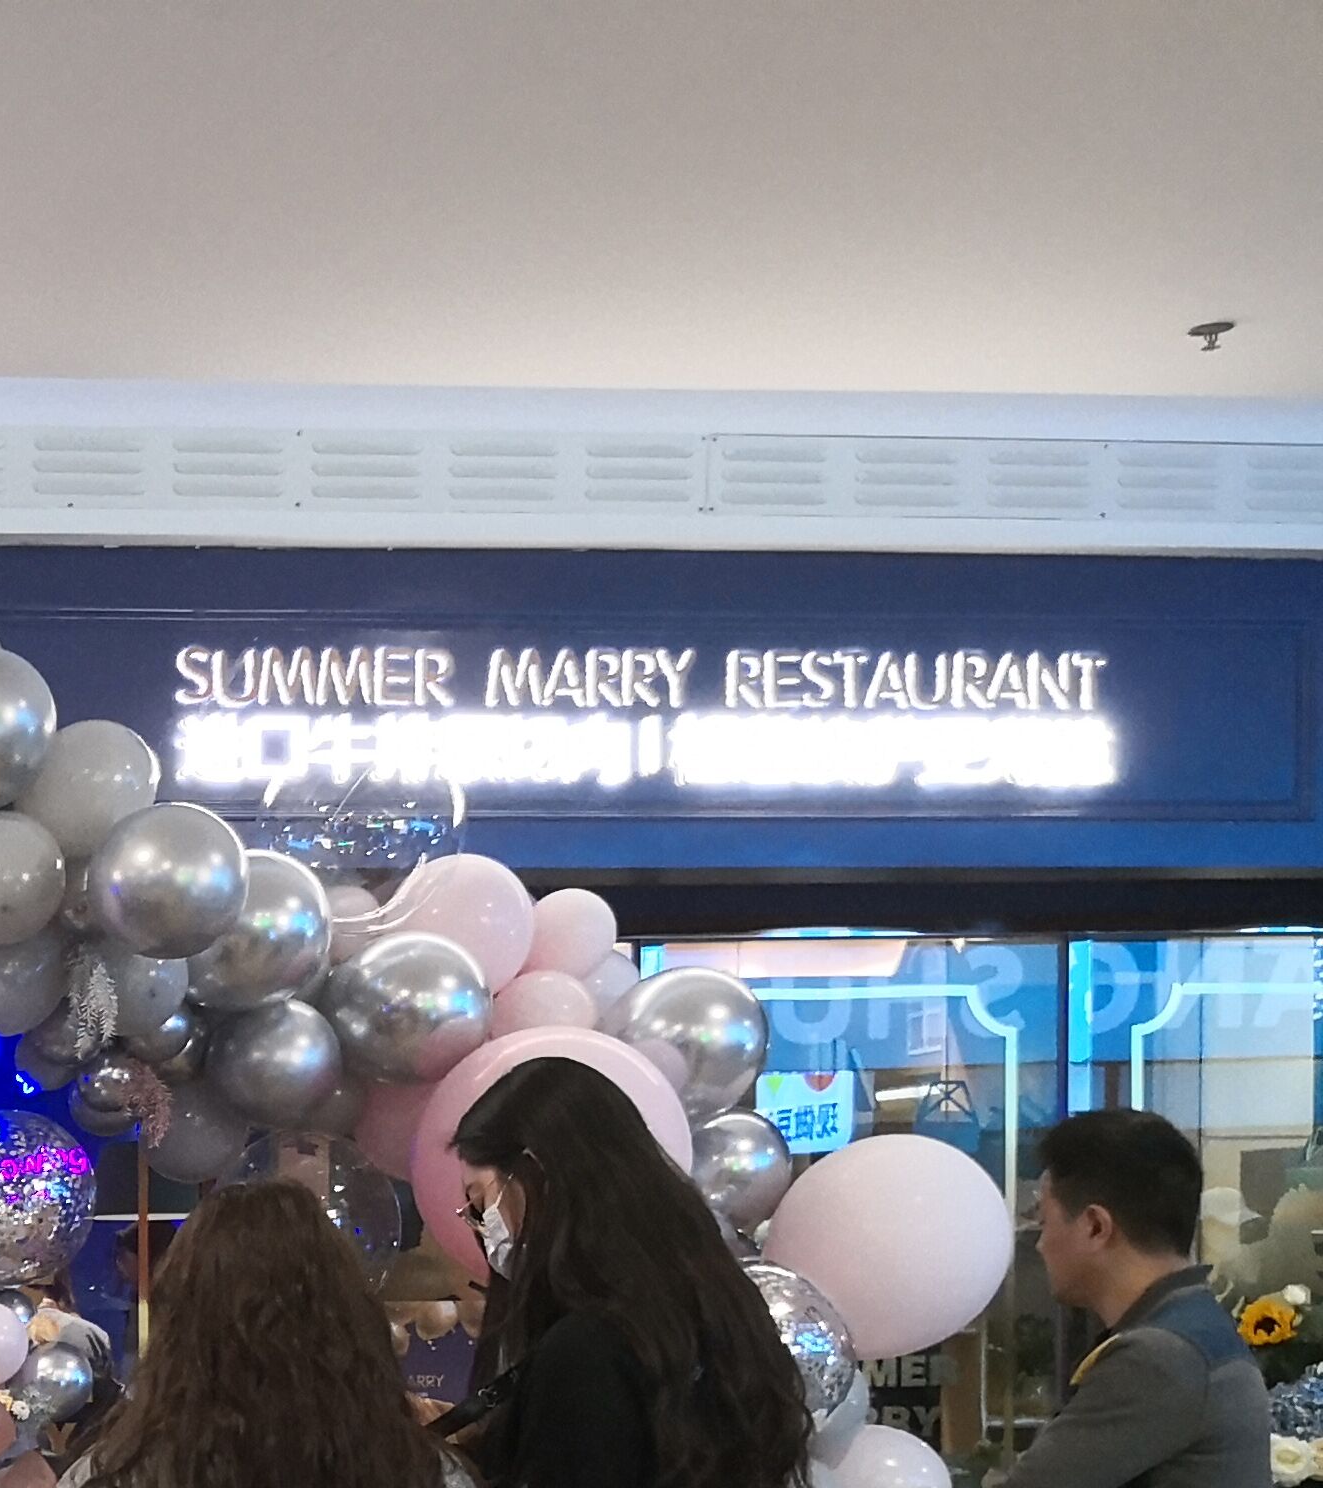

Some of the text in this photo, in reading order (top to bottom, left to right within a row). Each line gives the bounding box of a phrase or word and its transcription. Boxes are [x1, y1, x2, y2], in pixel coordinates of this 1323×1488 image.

[173, 646, 1108, 712] SUMMER MARRY RESTAURANT
